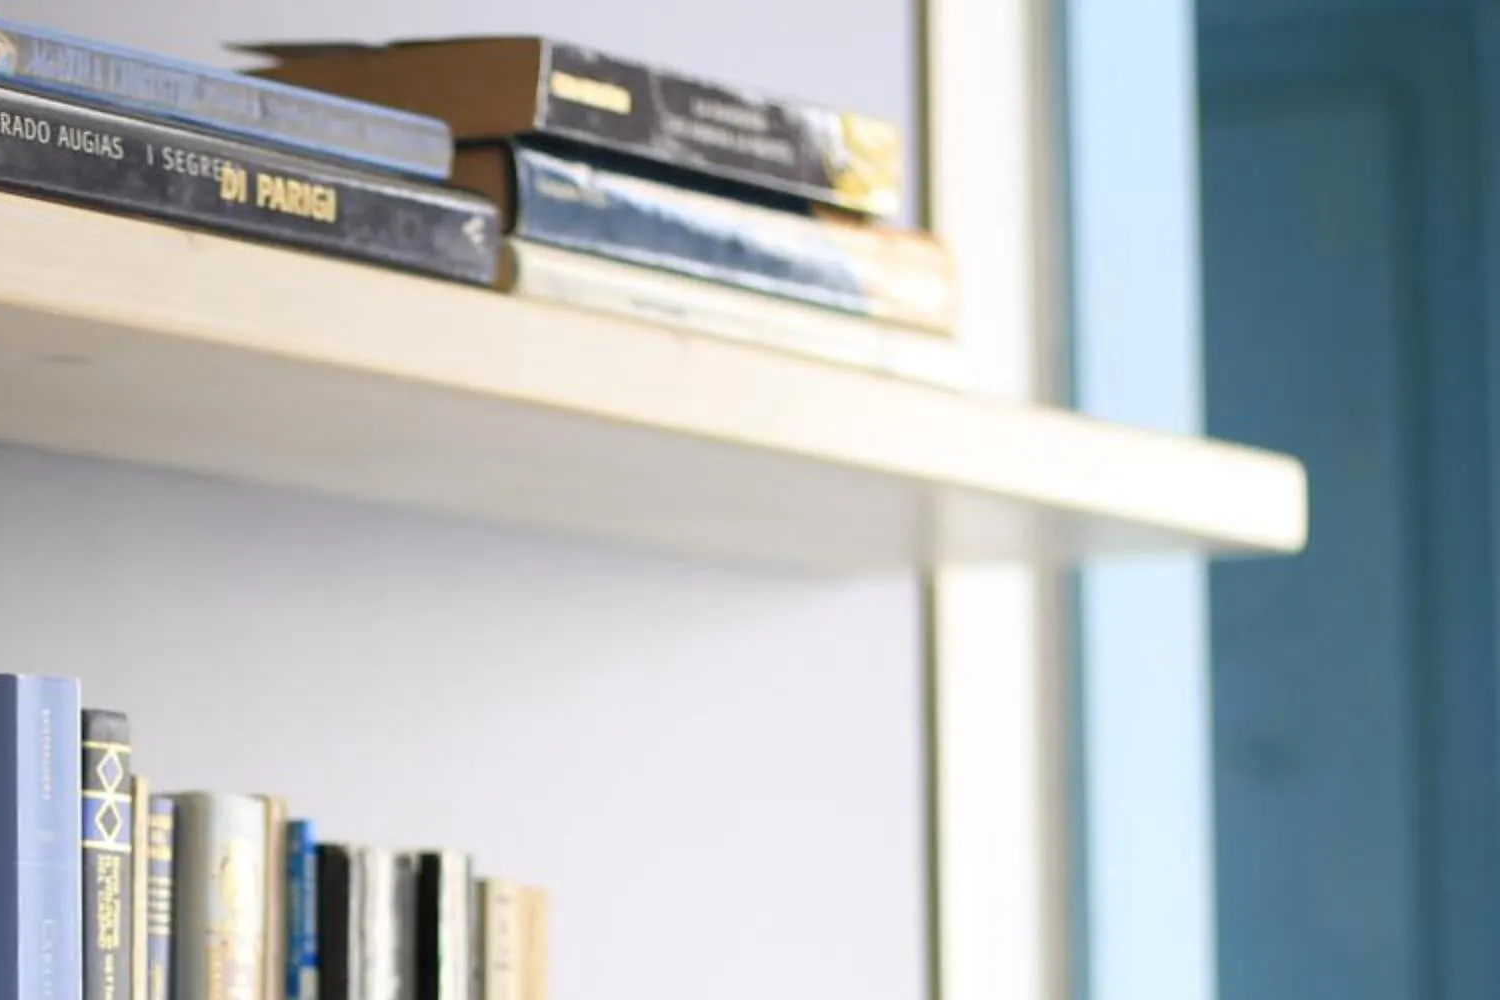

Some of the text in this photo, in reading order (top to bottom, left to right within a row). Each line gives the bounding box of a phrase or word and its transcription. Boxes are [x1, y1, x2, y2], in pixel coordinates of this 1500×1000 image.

[57, 125, 124, 160] AUGIAS
[146, 143, 154, 167] I
[220, 166, 247, 203] DI
[256, 172, 337, 224] PARIGI
